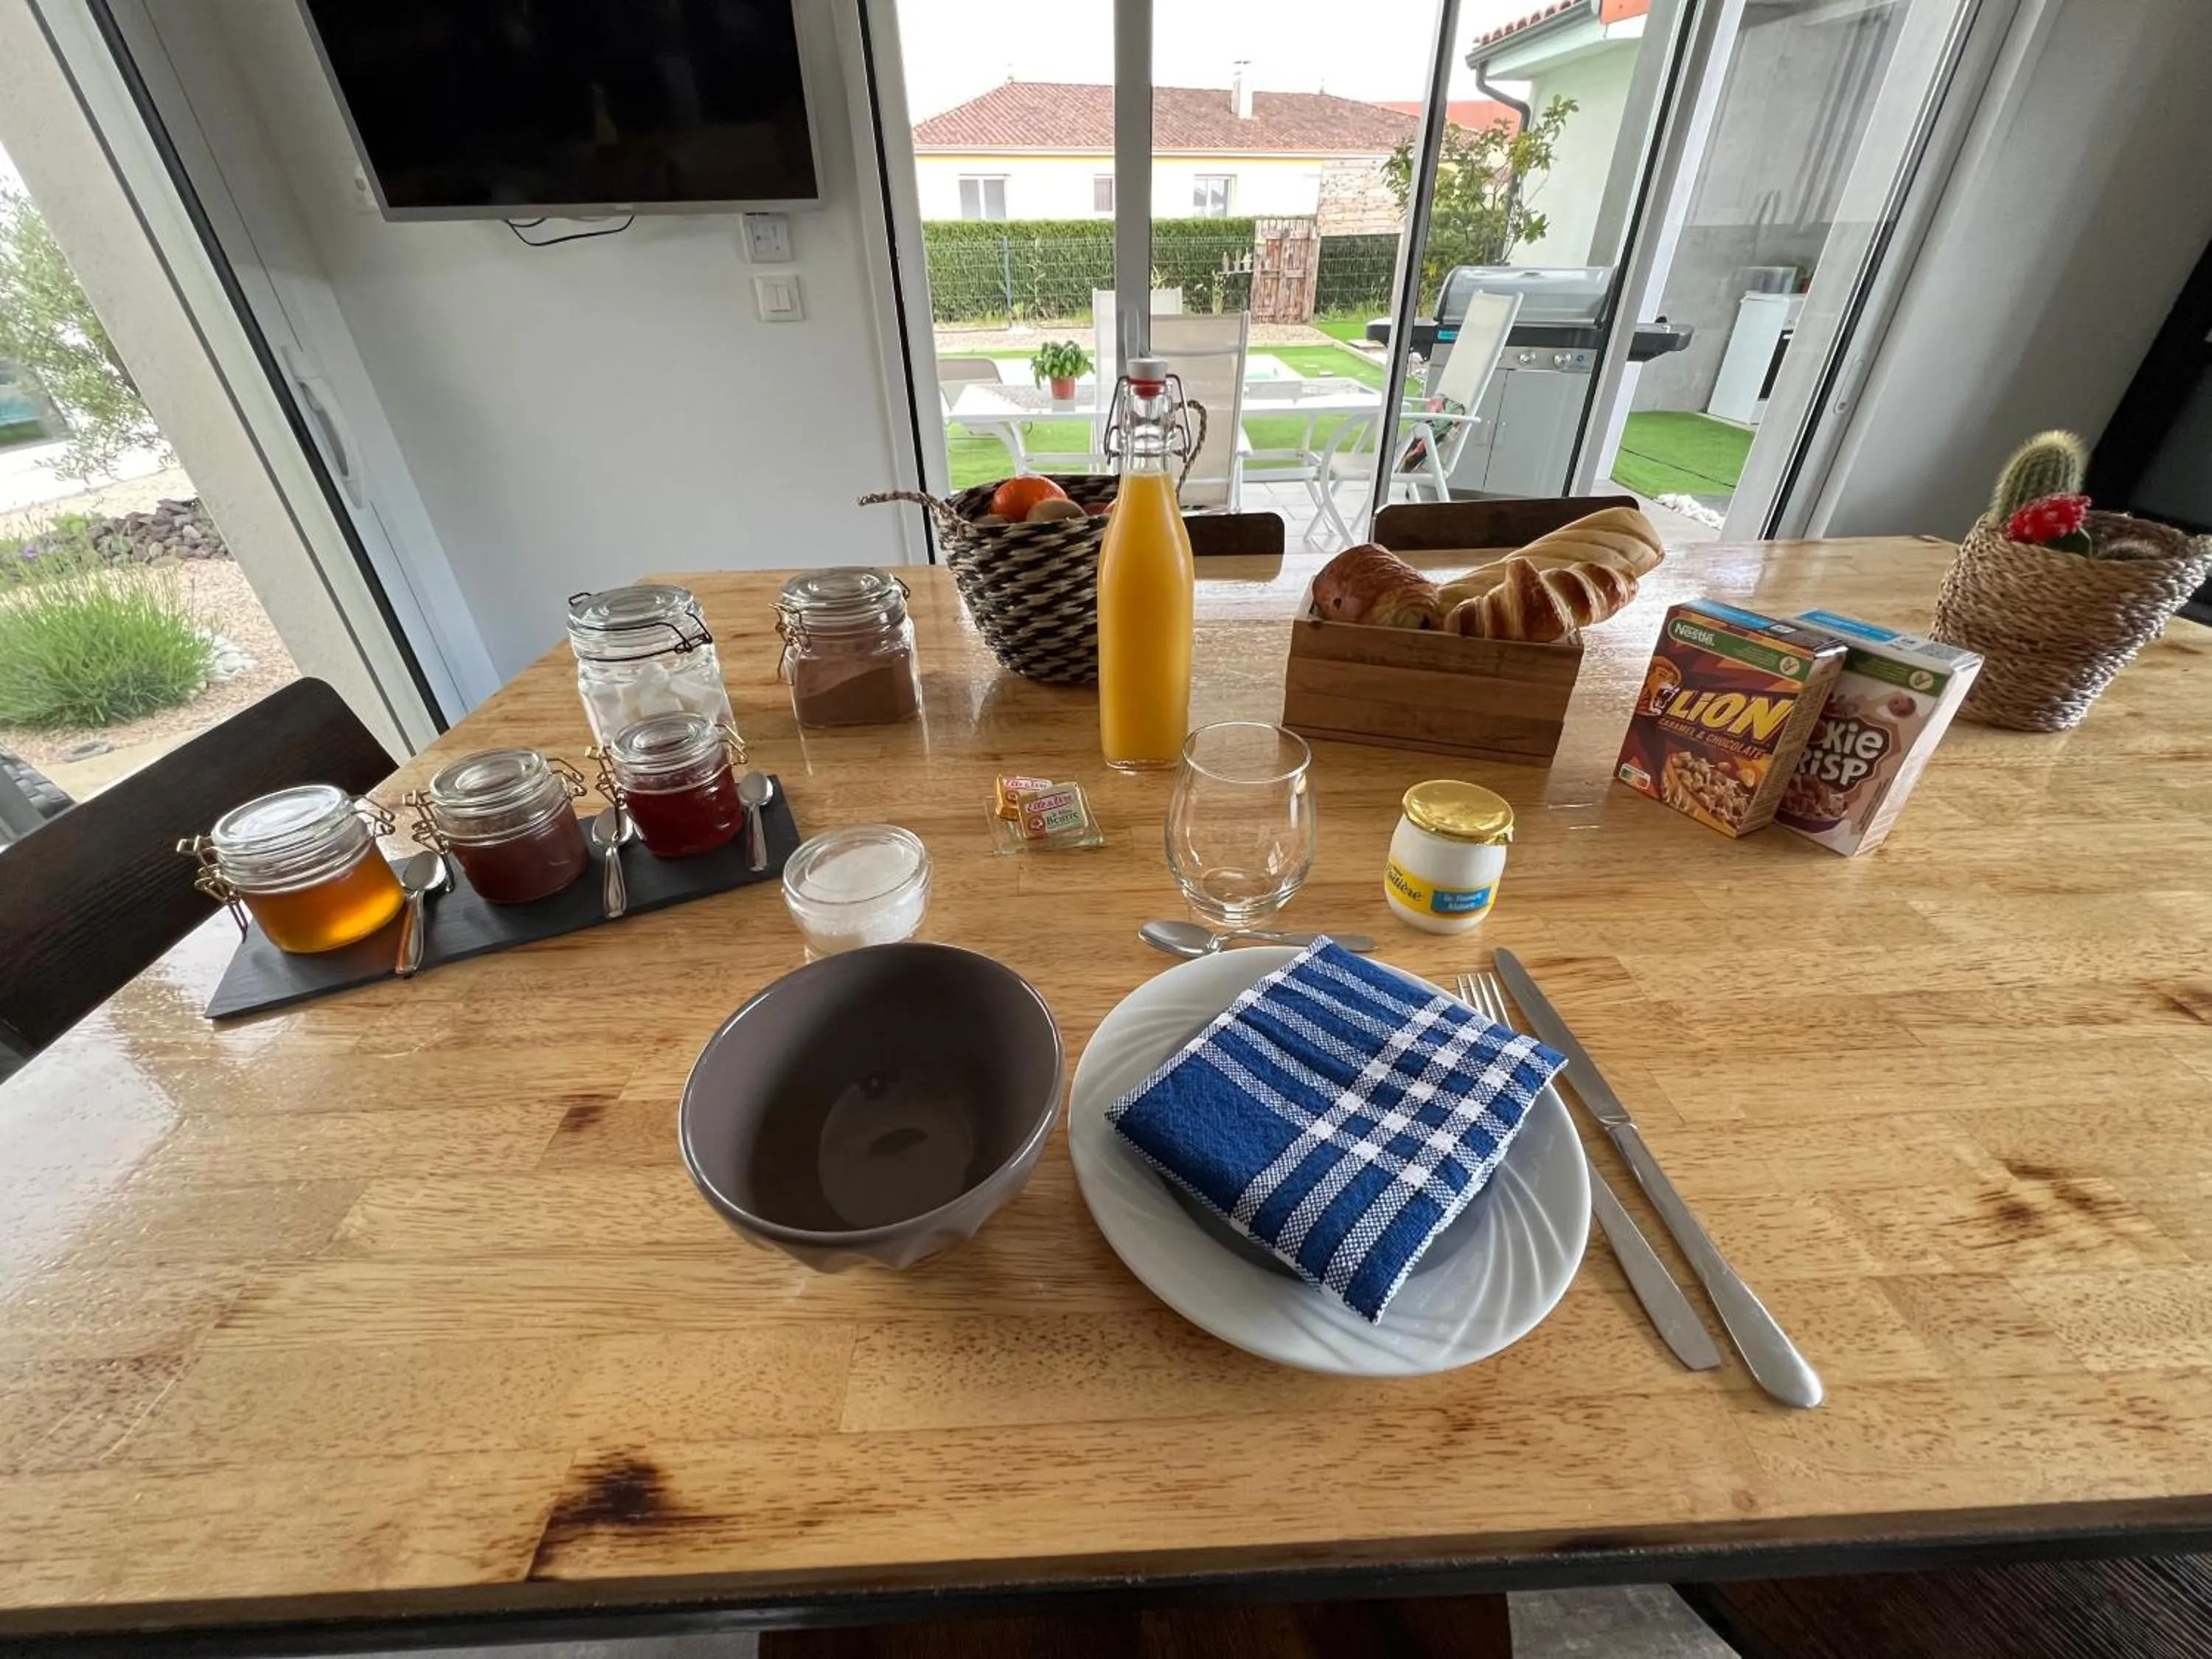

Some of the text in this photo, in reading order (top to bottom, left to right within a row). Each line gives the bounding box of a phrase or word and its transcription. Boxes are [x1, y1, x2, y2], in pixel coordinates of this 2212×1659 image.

[1659, 718, 1765, 759] CARAMEL & CHOCOLATE
